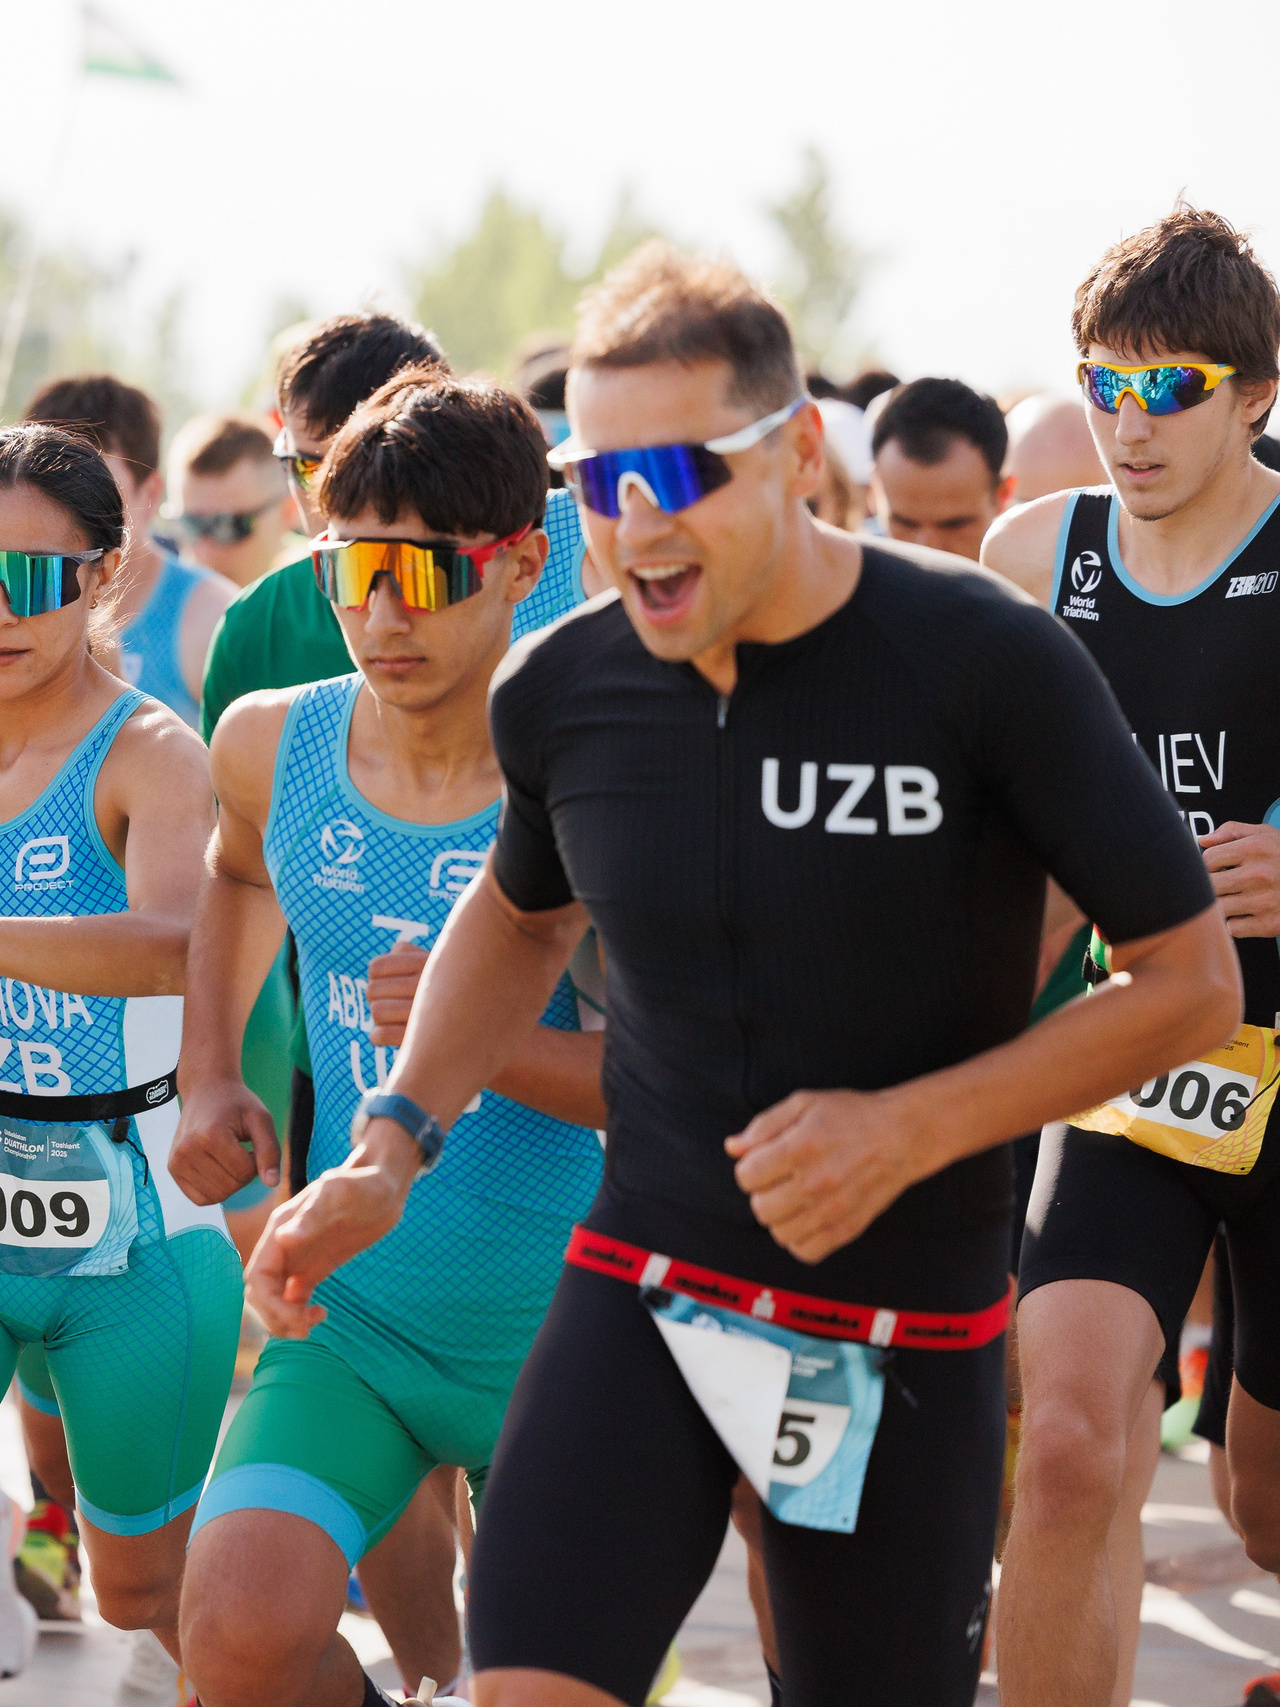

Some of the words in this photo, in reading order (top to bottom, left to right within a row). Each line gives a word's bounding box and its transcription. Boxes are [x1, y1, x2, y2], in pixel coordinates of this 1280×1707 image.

[1069, 595, 1096, 609] World
[1062, 605, 1100, 622] Triathlon
[1132, 731, 1226, 793] IEV
[761, 757, 944, 836] UZB
[320, 864, 358, 880] World
[14, 879, 74, 892] PROJECT
[312, 873, 365, 893] Triathlon
[4, 1137, 44, 1153] DUATHLON
[50, 1140, 80, 1149] Tashkent
[3, 1147, 37, 1160] Championship
[50, 1149, 68, 1158] 2025
